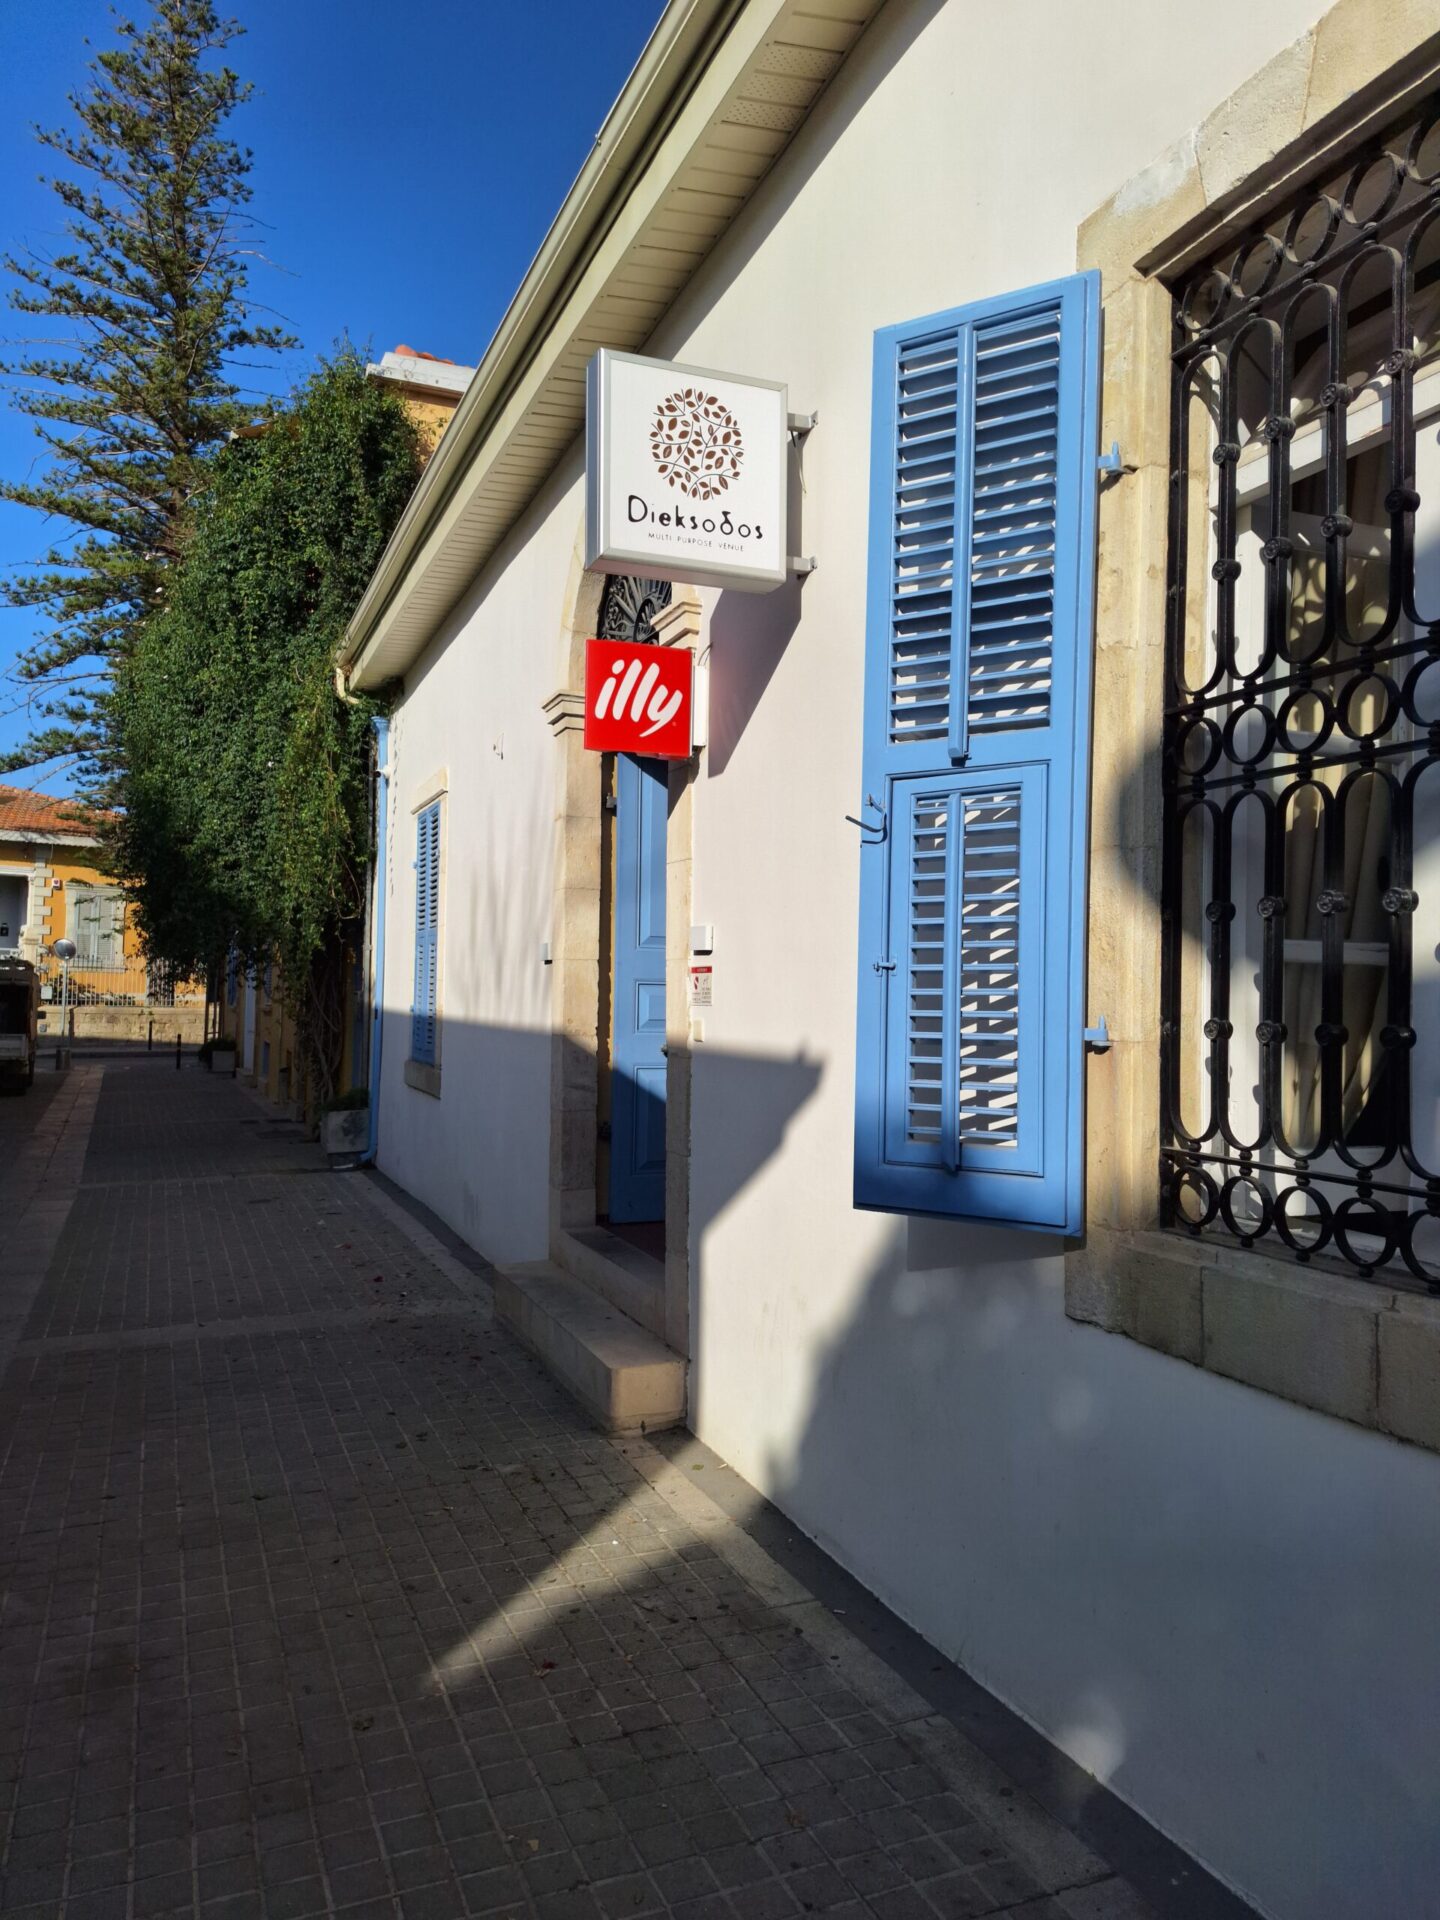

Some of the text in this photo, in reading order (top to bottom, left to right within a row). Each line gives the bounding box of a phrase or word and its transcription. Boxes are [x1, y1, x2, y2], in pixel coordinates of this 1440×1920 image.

[648, 532, 744, 552] MULTI PURPOSE VENUE
[594, 658, 683, 738] illy
